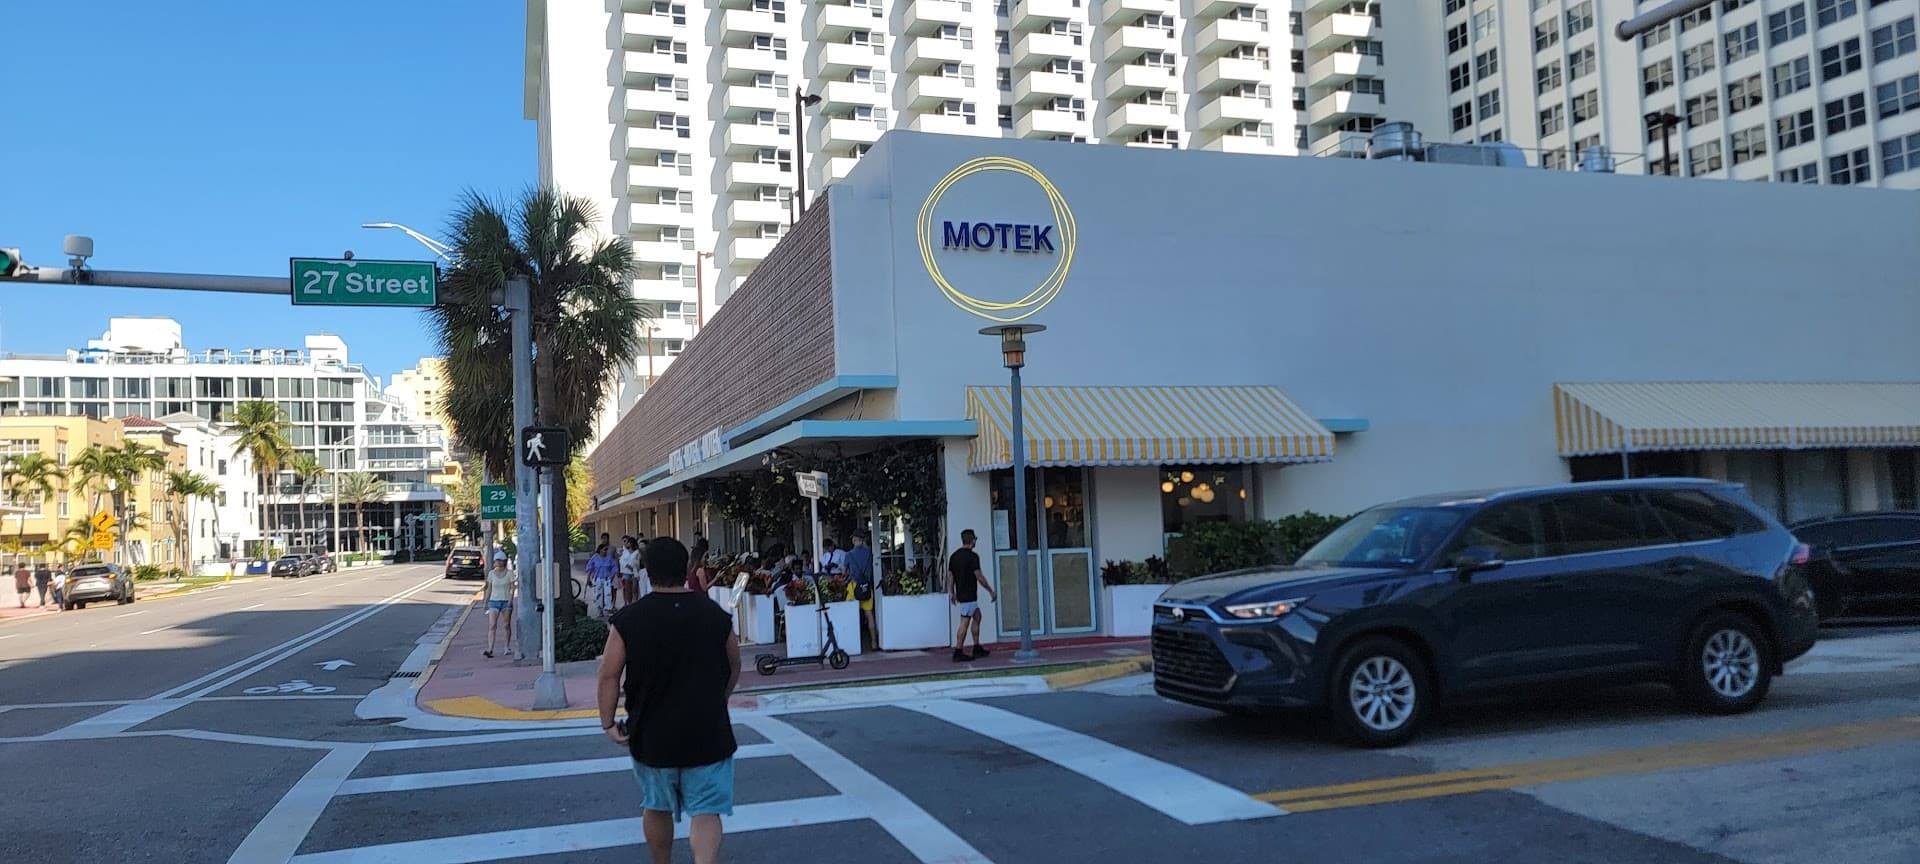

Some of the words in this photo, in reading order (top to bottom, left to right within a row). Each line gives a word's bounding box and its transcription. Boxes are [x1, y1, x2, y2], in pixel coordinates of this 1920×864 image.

[943, 221, 1055, 252] MOTEK
[303, 270, 340, 295] 27
[345, 271, 429, 294] Street
[490, 490, 507, 501] 29
[482, 504, 500, 513] NEXT
[96, 534, 111, 542] 25
